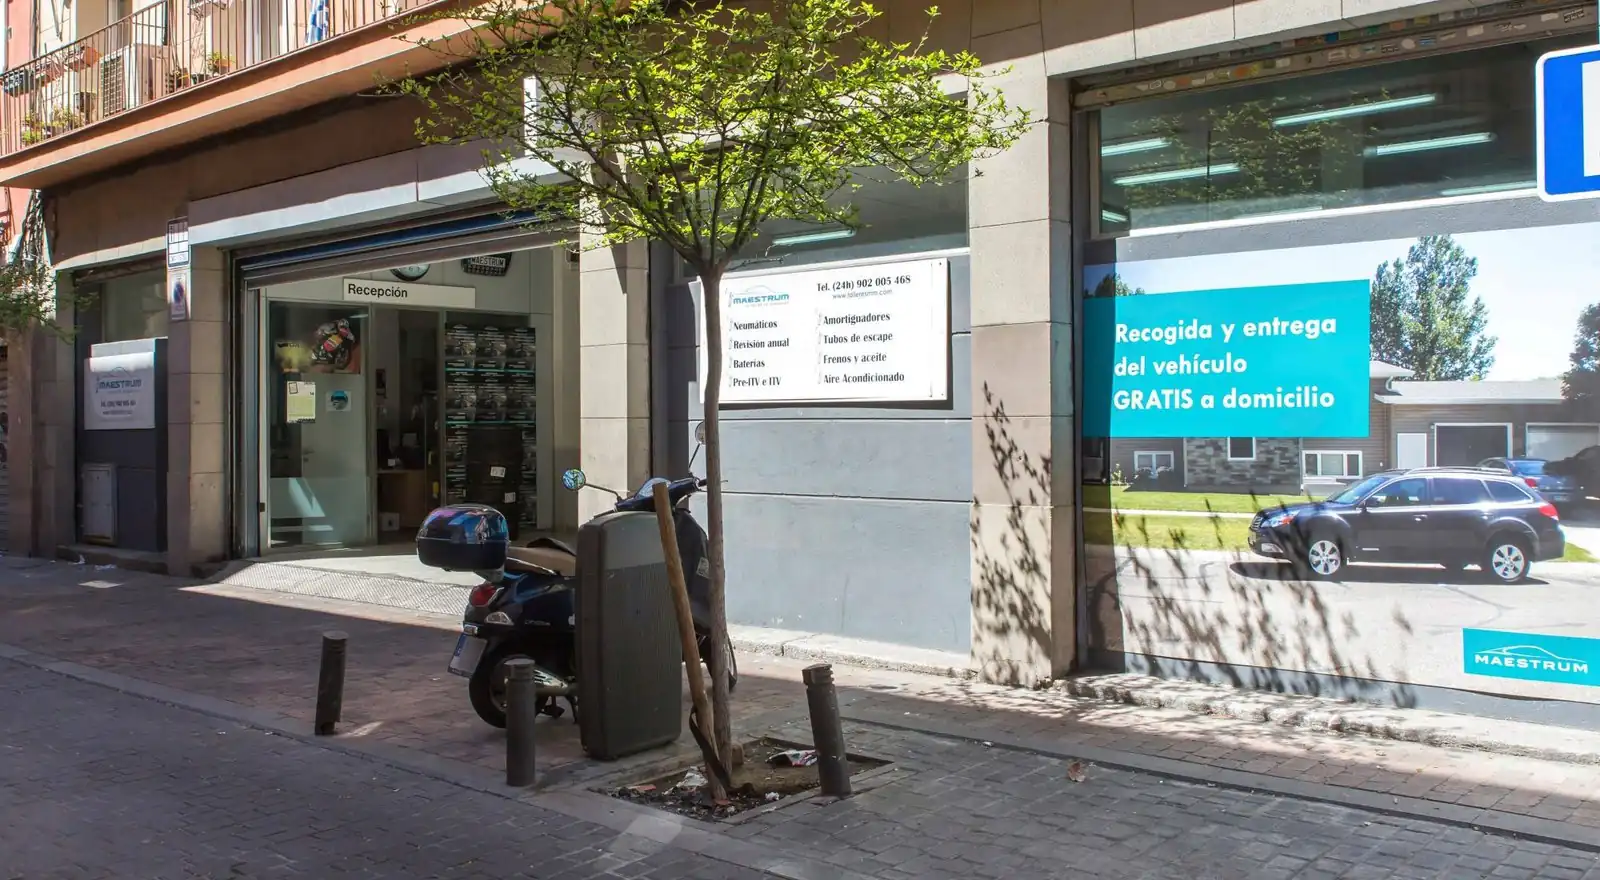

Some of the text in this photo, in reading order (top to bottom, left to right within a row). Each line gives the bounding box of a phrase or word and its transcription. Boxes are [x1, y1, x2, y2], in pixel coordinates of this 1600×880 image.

[818, 274, 910, 291] Tel. (24h) 902 005 468
[348, 283, 408, 299] Recepción
[733, 293, 789, 304] MAESTRUM
[824, 312, 890, 325] Amortiguadores
[1116, 317, 1336, 345] Recogida y entrega
[768, 337, 789, 347] anual
[824, 333, 892, 344] Tubos de escape
[824, 352, 886, 364] Frenos y aceite
[1115, 352, 1247, 376] del vehículo
[733, 377, 760, 387] Pre-ITV
[768, 376, 781, 386] ITV
[824, 371, 904, 383] Aire Acondicionado
[1114, 386, 1334, 409] GRATIS a domicilio
[1475, 654, 1588, 674] MAESTRUM
